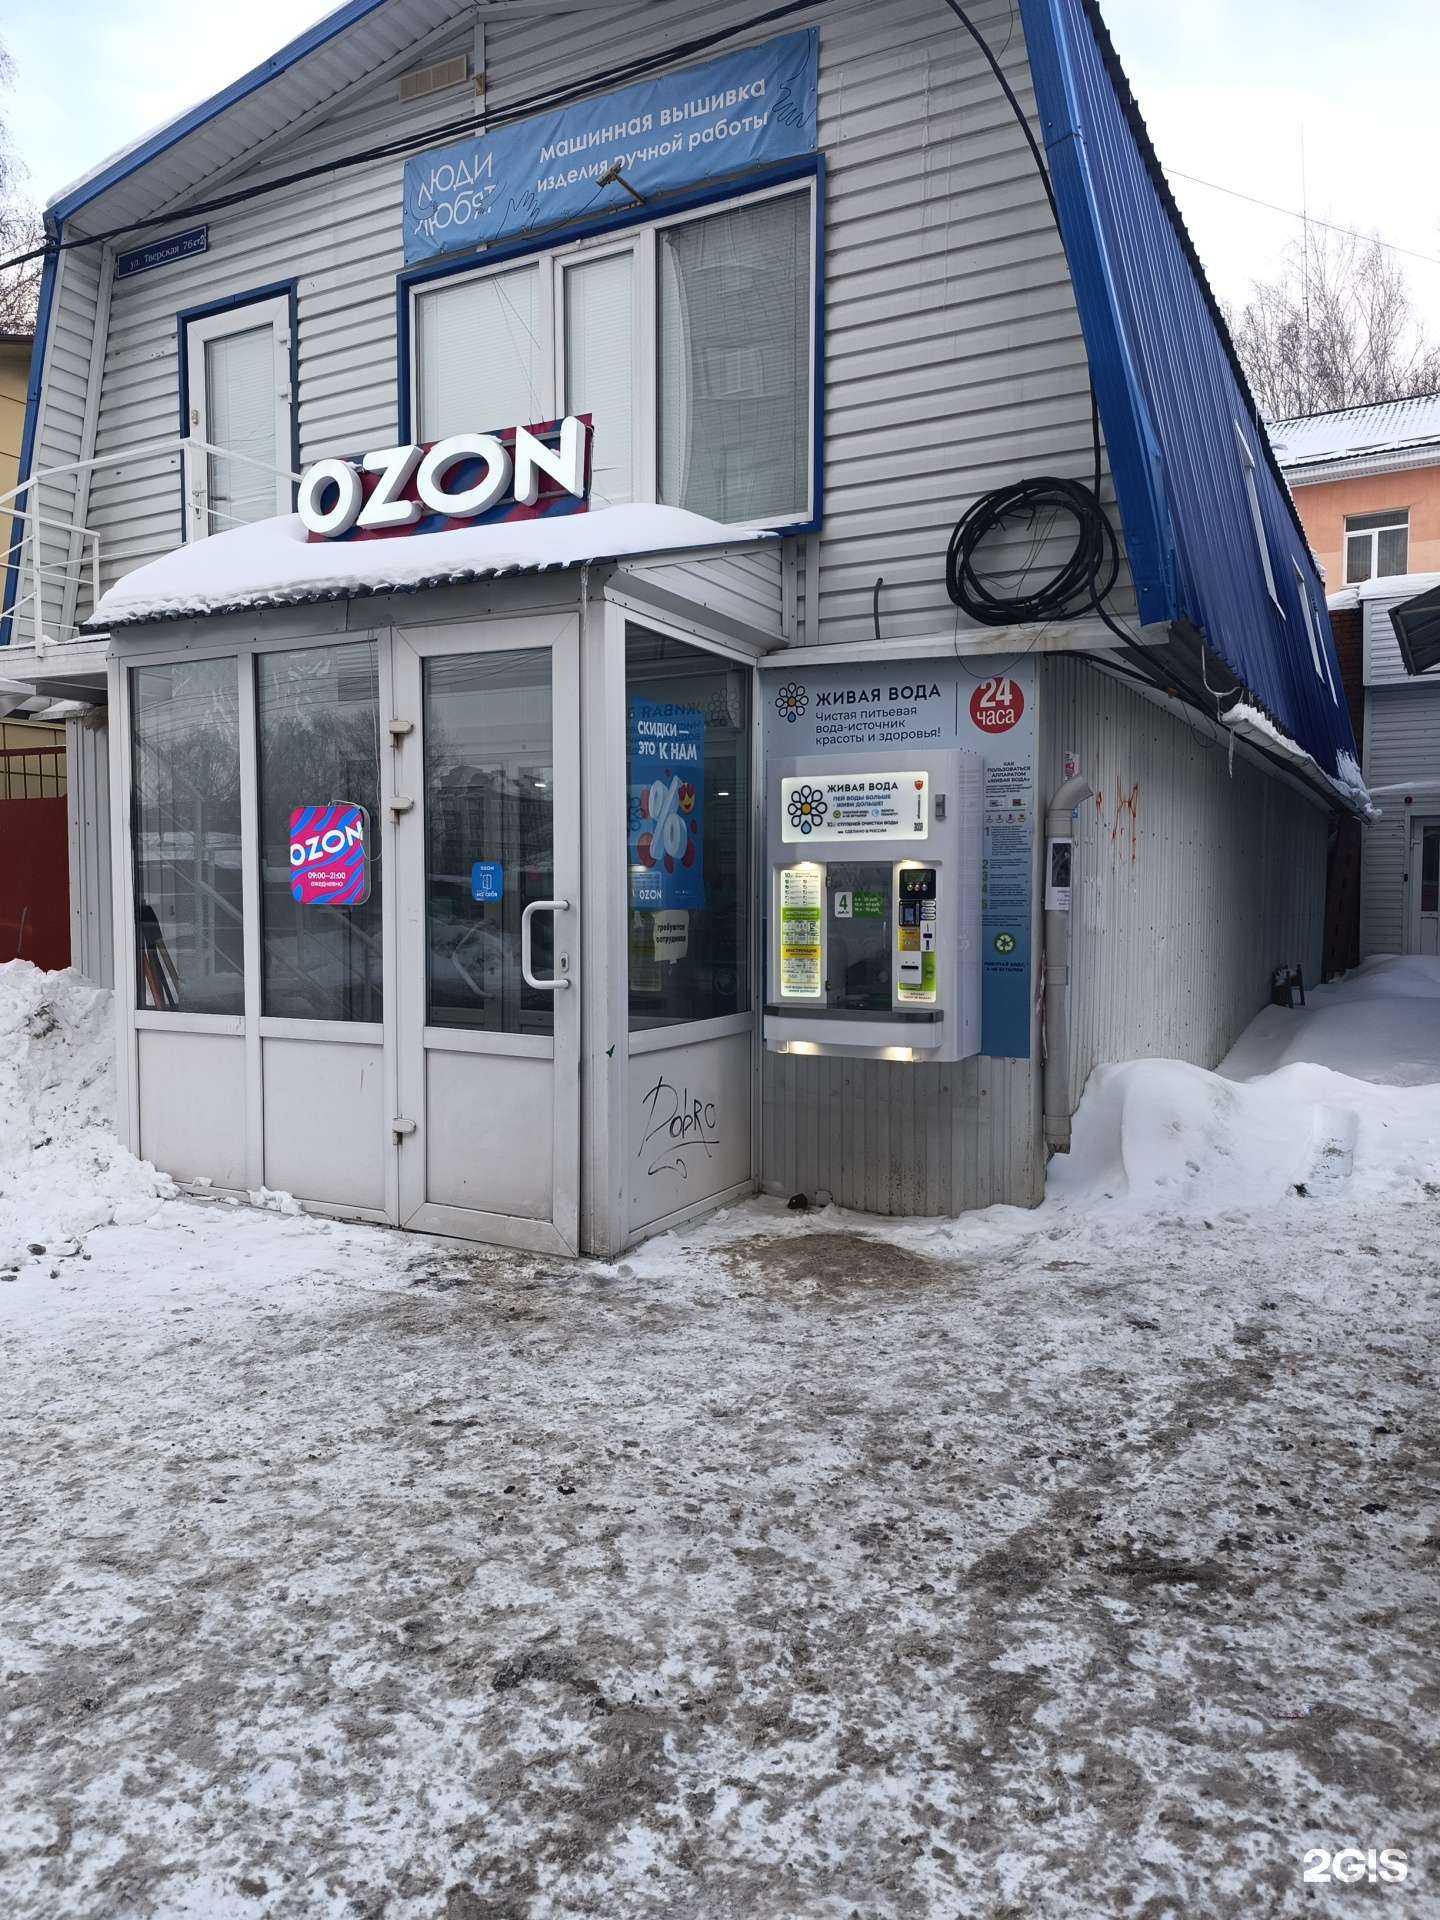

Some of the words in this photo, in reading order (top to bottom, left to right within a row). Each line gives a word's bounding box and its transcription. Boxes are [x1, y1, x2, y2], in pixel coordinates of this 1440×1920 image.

[539, 114, 652, 163] машинная
[660, 78, 766, 126] вышивка
[537, 158, 608, 193] изделия
[688, 112, 768, 151] работы
[144, 245, 180, 263] Тверская
[298, 416, 585, 537] OZON
[816, 688, 881, 706] ЖИВАЯ
[889, 684, 941, 701] ВОДА
[980, 677, 1013, 708] 24
[816, 711, 857, 721] Чистая
[860, 707, 917, 719] питьевая
[977, 709, 1015, 725] часа
[638, 721, 677, 738] СКИДКИ
[816, 720, 906, 733] вода-источник
[816, 734, 864, 746] красоты
[868, 733, 875, 741] и
[880, 728, 941, 742] здоровья!
[638, 741, 656, 755] ЭТО
[660, 743, 668, 760] К
[671, 743, 697, 760] НАМ
[827, 783, 865, 793] ЖИВАЯ
[868, 782, 898, 791] ВОДА
[290, 821, 363, 866] OZON
[640, 889, 662, 900] OZON
[839, 894, 848, 910] 4
